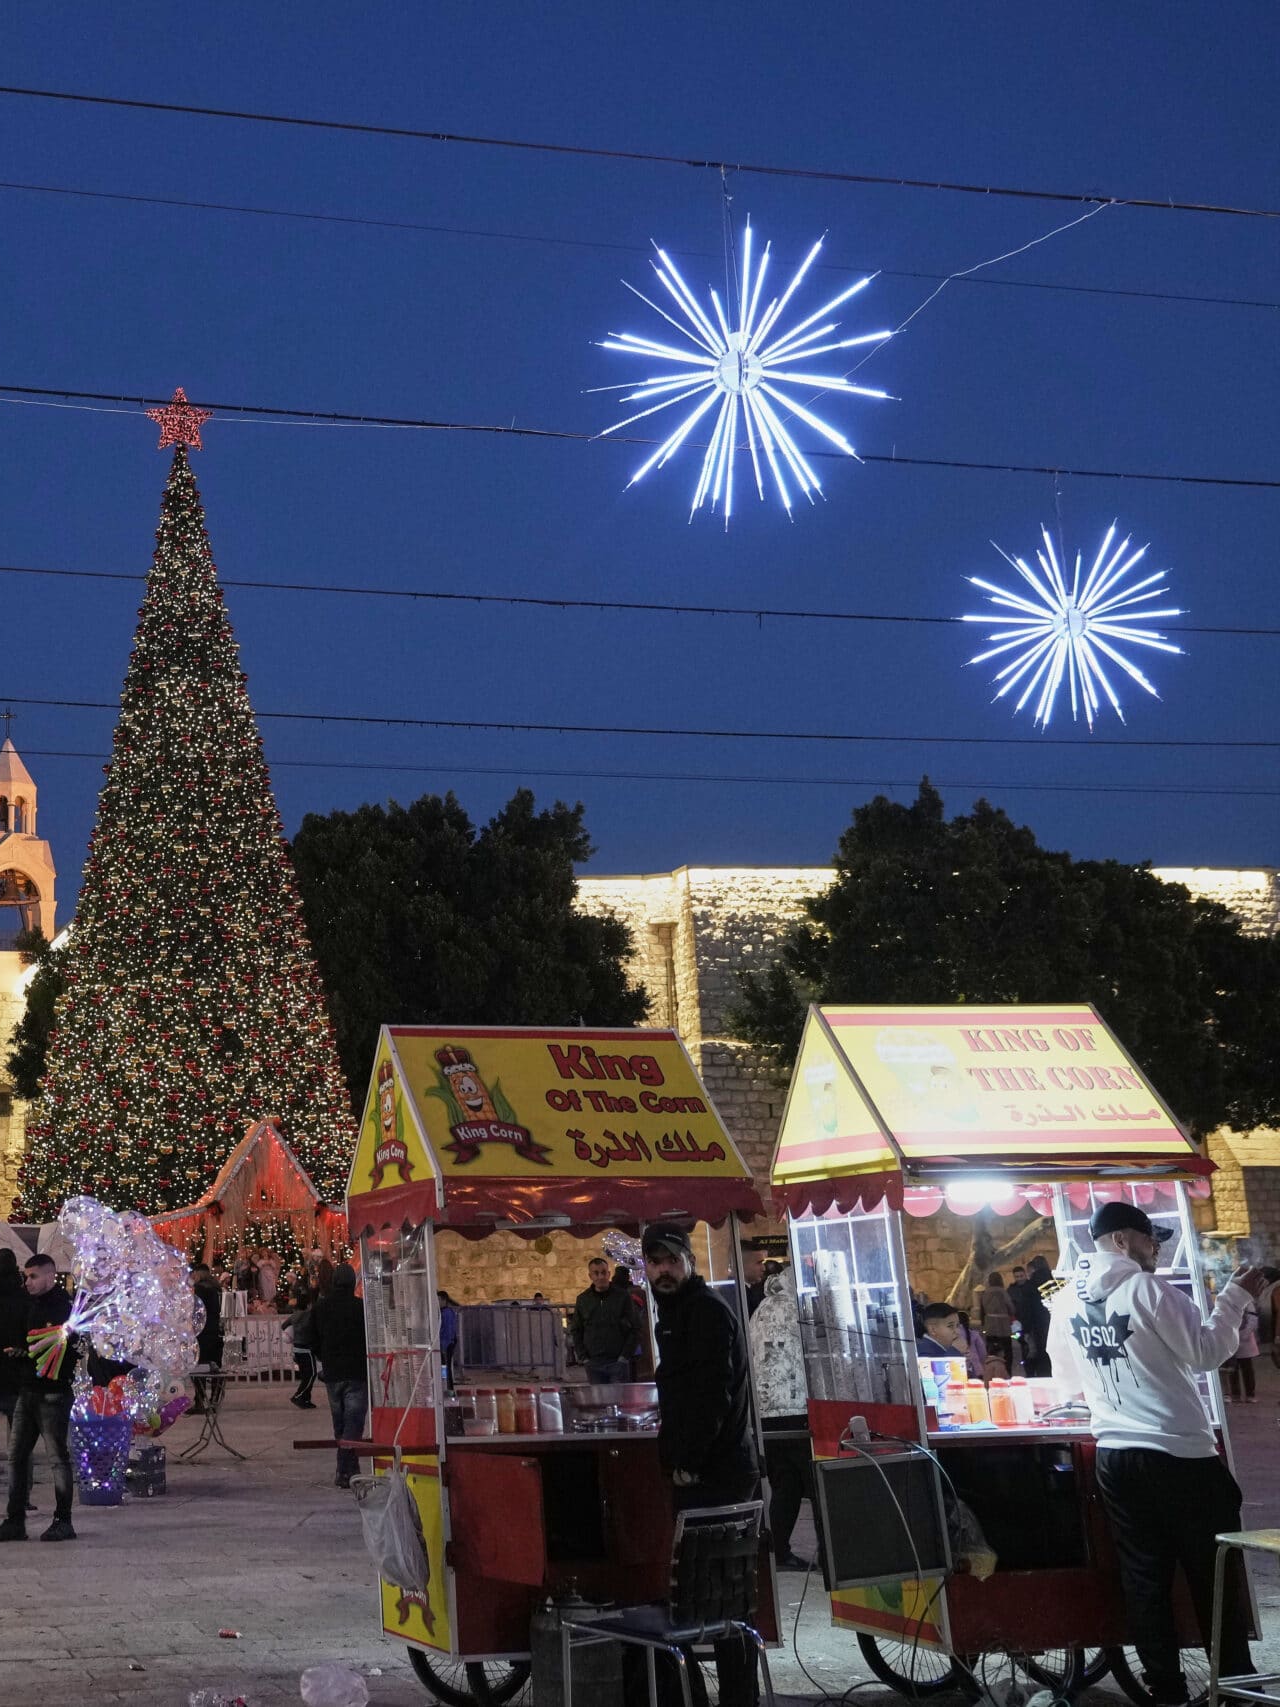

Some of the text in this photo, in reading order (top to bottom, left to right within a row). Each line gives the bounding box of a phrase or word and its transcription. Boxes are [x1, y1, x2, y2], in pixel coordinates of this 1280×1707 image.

[961, 1028, 1097, 1053] KING OF
[546, 1044, 665, 1087] King
[968, 1066, 1144, 1091] THE CORN
[545, 1089, 708, 1114] Of The Corn
[455, 1124, 523, 1142] King Corn
[376, 1144, 405, 1164] King Corn
[565, 1127, 726, 1168] ملك الذرة
[1080, 1325, 1120, 1348] DSQ2
